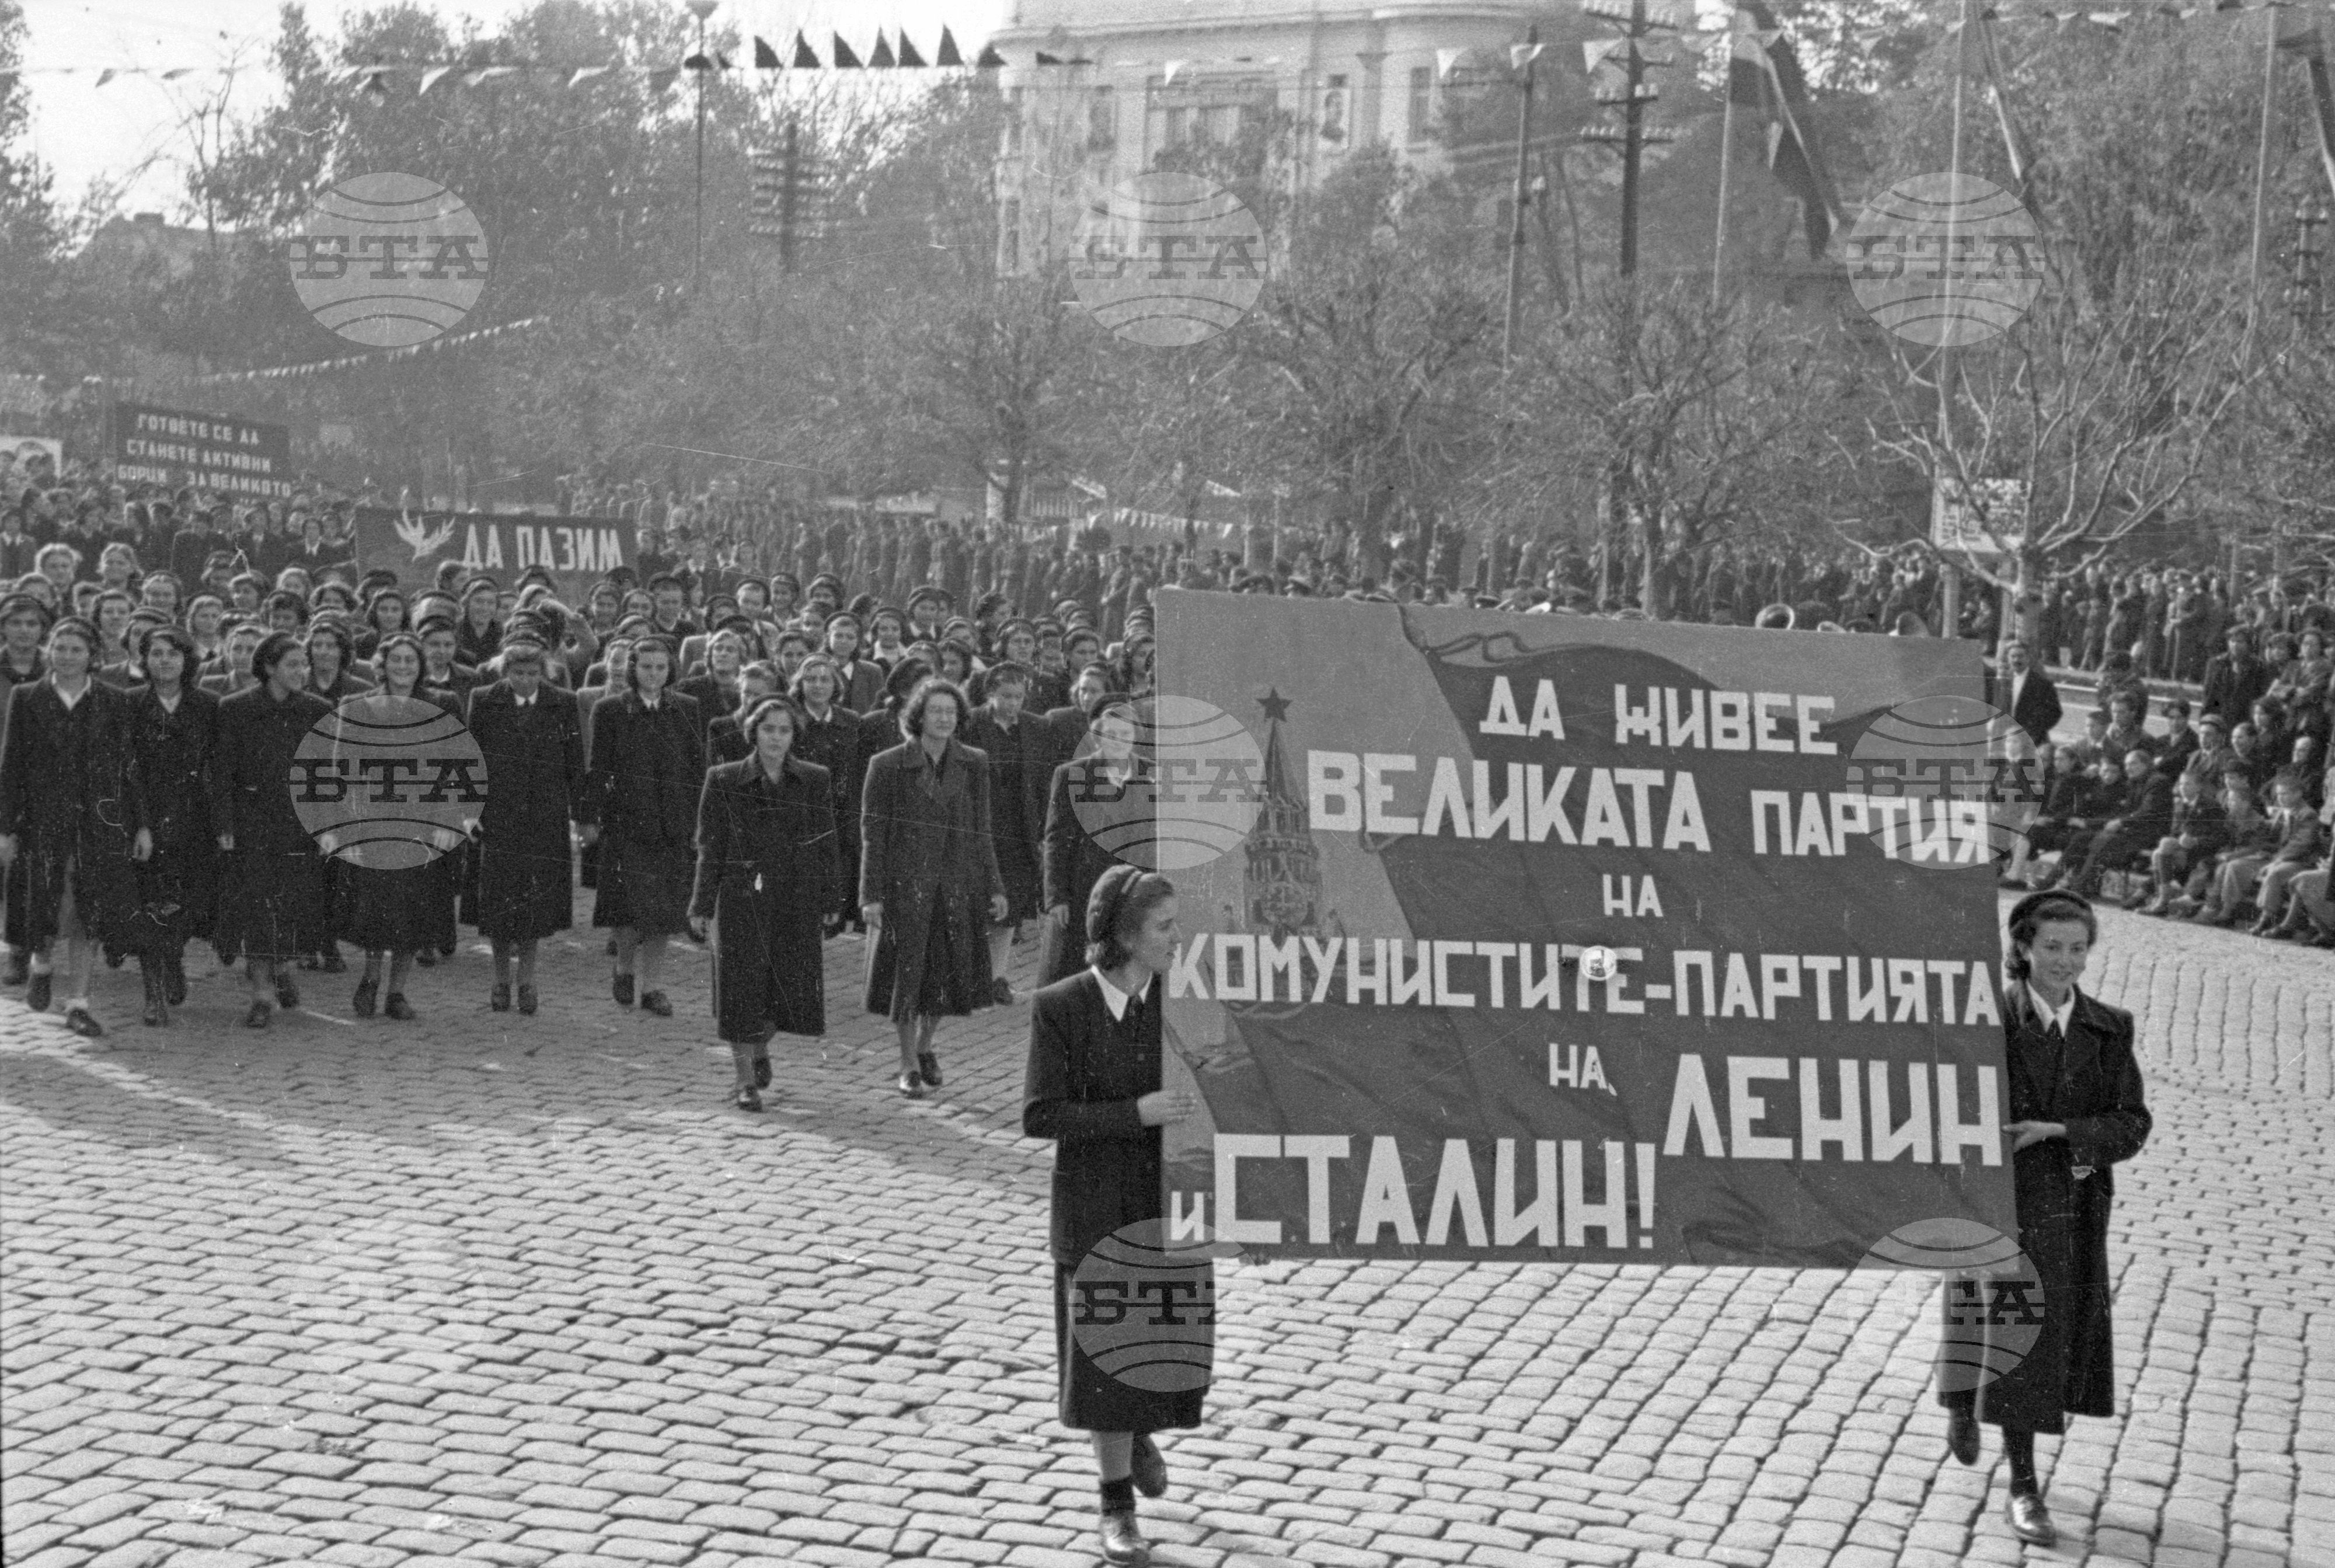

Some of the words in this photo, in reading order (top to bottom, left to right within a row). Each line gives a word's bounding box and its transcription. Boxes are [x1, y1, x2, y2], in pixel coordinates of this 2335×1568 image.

[126, 439, 197, 463] СТАНЕТЕ
[203, 450, 271, 472] АКТИВНИ
[212, 424, 232, 441] СЕ
[239, 428, 260, 445] ДА
[186, 470, 207, 486] ЗА
[210, 472, 291, 497] ВЕЛИКОТО
[465, 523, 503, 570] ДА
[516, 525, 623, 572] ПАЗИМ
[1479, 675, 1565, 740] ДА
[1615, 684, 1837, 755] ЖИВЕЕ
[1308, 750, 1711, 852] ВЕЛИКАТА
[1751, 790, 1989, 864] ПАРТИЯ
[1602, 874, 1663, 917] НА
[1549, 1043, 1608, 1089] НА
[1663, 1053, 2003, 1166] ЛЕНИН
[1214, 1133, 1656, 1249] СТАЛИН!
